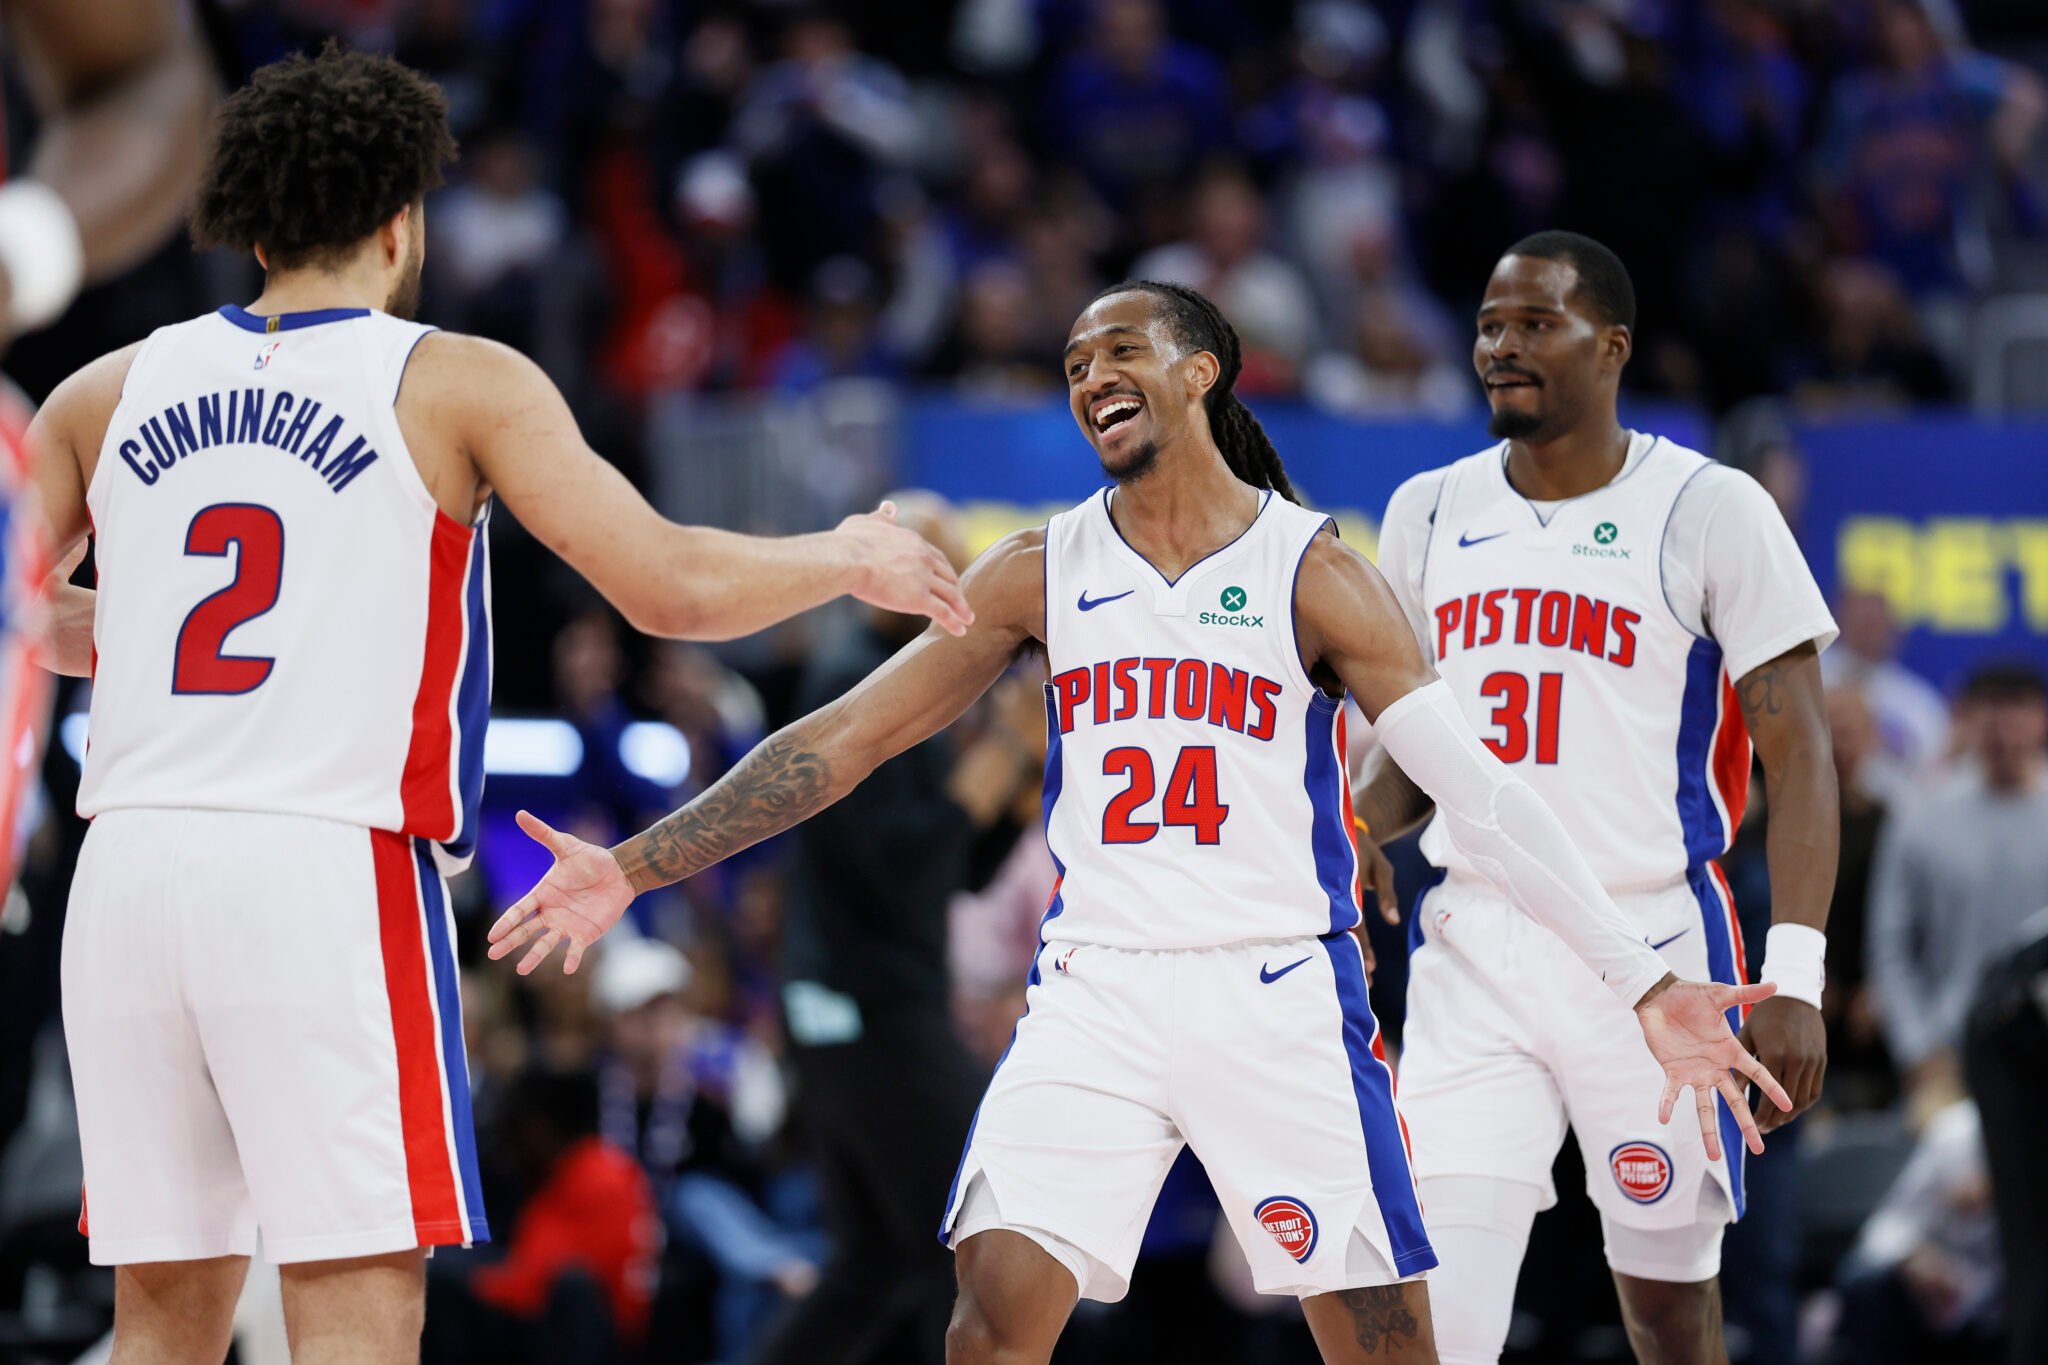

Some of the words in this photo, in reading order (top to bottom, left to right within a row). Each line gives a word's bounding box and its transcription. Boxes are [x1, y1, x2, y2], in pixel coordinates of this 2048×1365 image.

[119, 388, 379, 494] CUNNINGHAM
[1571, 543, 1632, 560] StockX
[171, 502, 285, 696] 2
[1199, 612, 1264, 628] StockX
[1434, 588, 1642, 669] PISTONS
[1053, 656, 1282, 742] PISTONS
[1479, 671, 1563, 765] 31
[1101, 745, 1229, 846] 24
